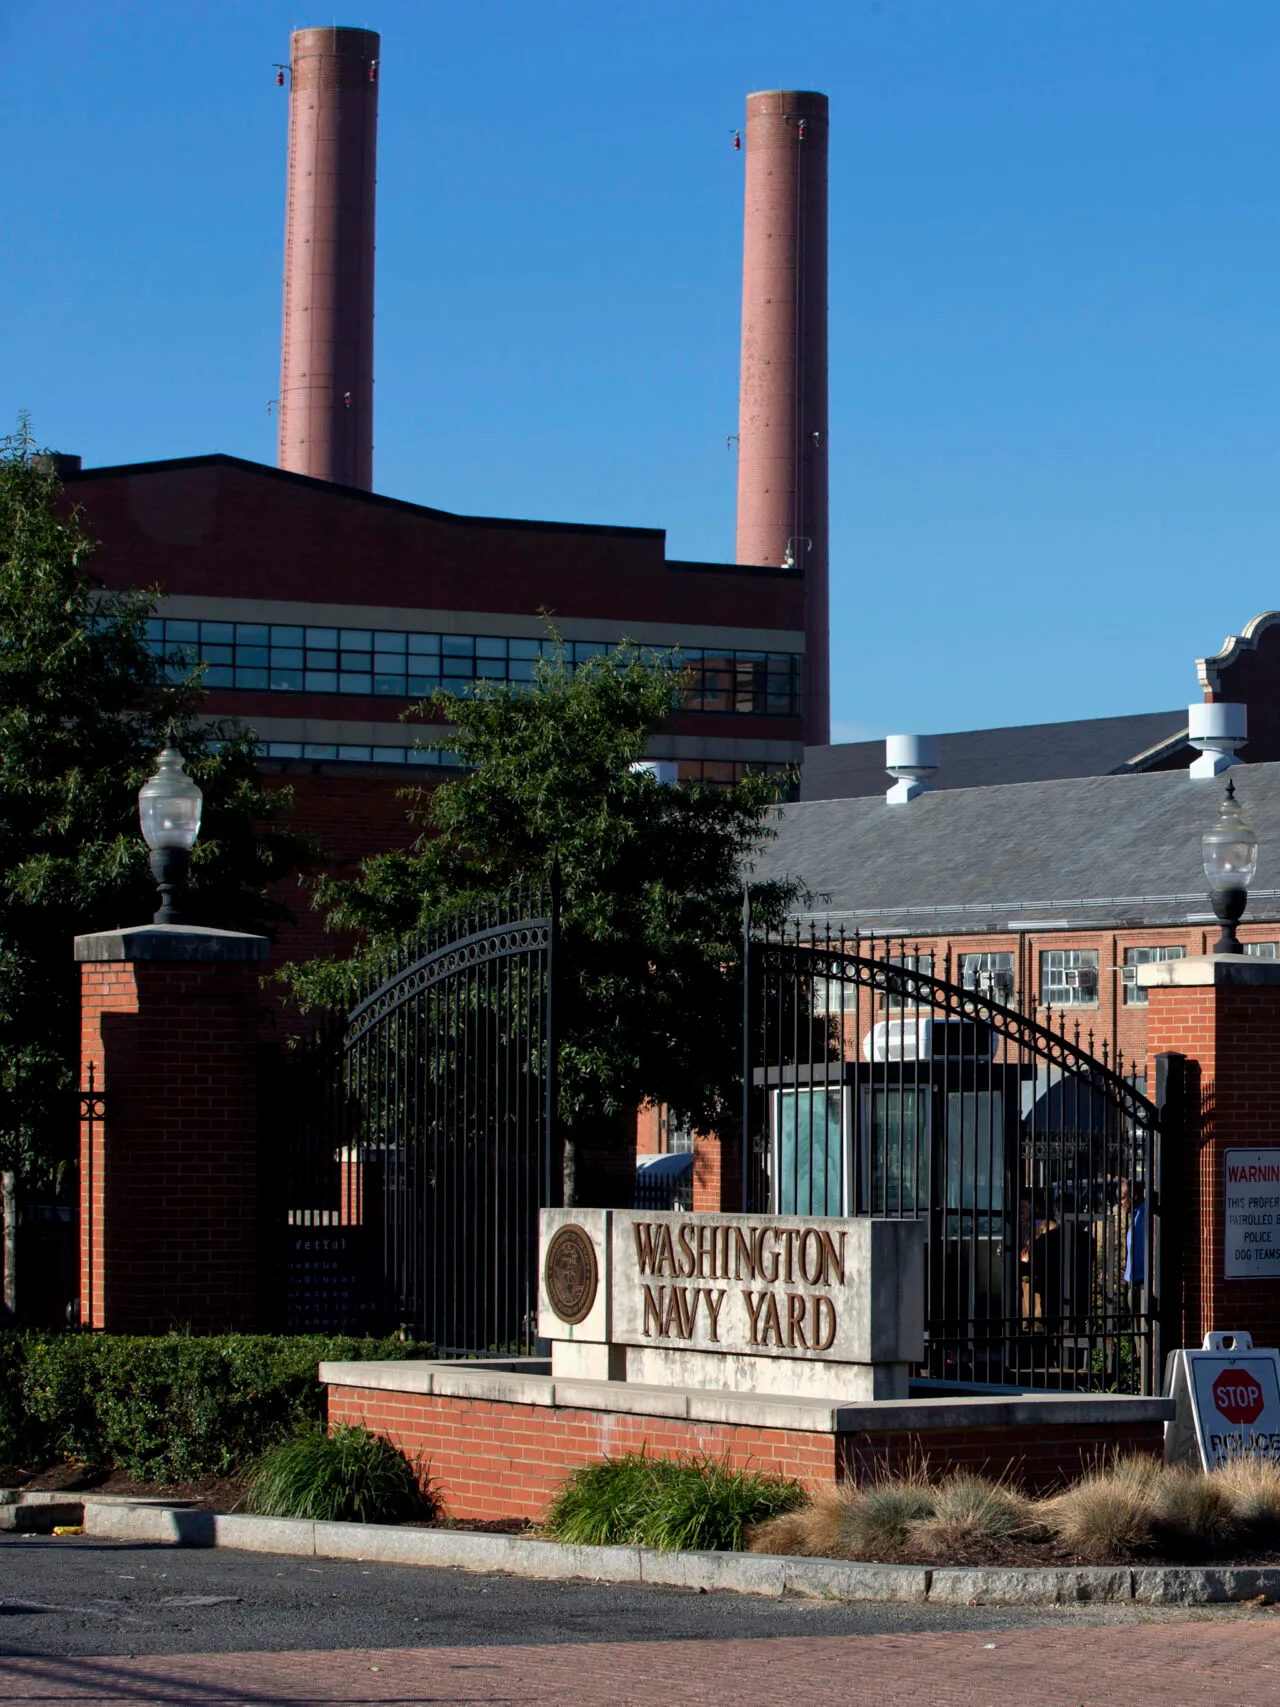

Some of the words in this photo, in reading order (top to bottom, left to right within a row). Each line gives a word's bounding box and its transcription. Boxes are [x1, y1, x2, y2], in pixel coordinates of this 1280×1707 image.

[1228, 1197, 1244, 1209] THIS
[1229, 1214, 1272, 1226] PATROLLED
[1244, 1232, 1271, 1243] POLICE
[632, 1221, 848, 1287] WASHINGTON
[1234, 1249, 1251, 1260] DOG
[1254, 1249, 1280, 1260] TEAMS
[642, 1284, 728, 1343] NAVY
[741, 1288, 837, 1351] YARD
[1216, 1386, 1258, 1408] STOP
